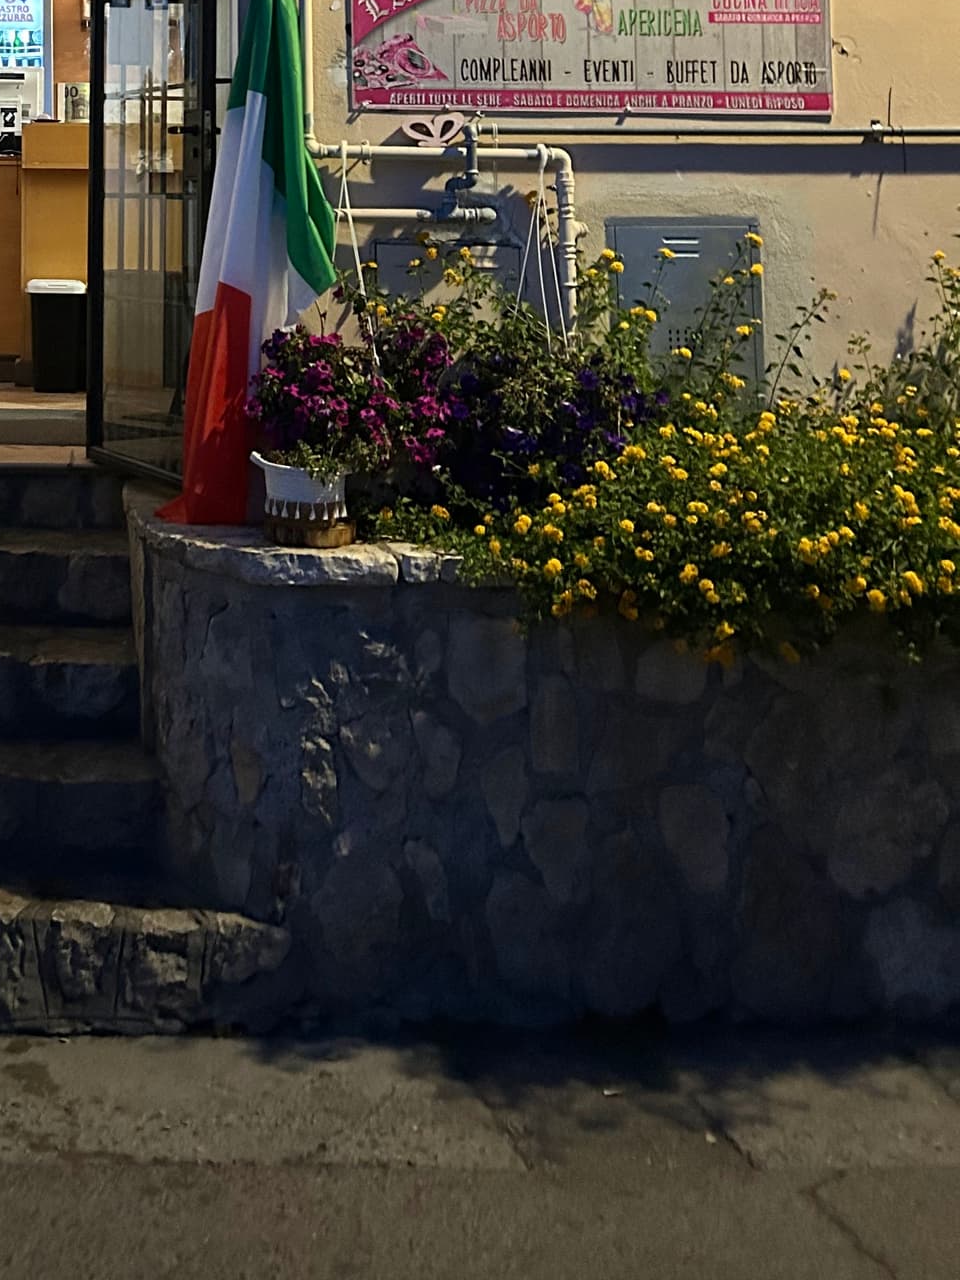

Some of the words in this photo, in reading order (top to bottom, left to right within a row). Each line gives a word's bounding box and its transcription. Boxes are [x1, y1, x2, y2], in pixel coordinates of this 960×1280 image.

[497, 13, 566, 42] ASPORTO
[618, 9, 703, 37] APERICENA
[460, 58, 552, 83] COMPLEANNI
[583, 59, 634, 83] EVENTI
[666, 60, 717, 84] BUFFET
[731, 61, 749, 84] DA
[761, 61, 817, 85] ASPORTO
[390, 93, 425, 105] APERTI
[429, 93, 457, 105] TUTTE
[462, 94, 472, 105] LE
[476, 94, 501, 106] SERE
[513, 94, 552, 106] SABATO
[556, 95, 561, 106] E
[566, 95, 620, 107] DOMENICA
[624, 95, 657, 108] ANCHE
[661, 96, 668, 108] A
[672, 96, 713, 108] PRANZO
[766, 96, 805, 110] RIPOSO
